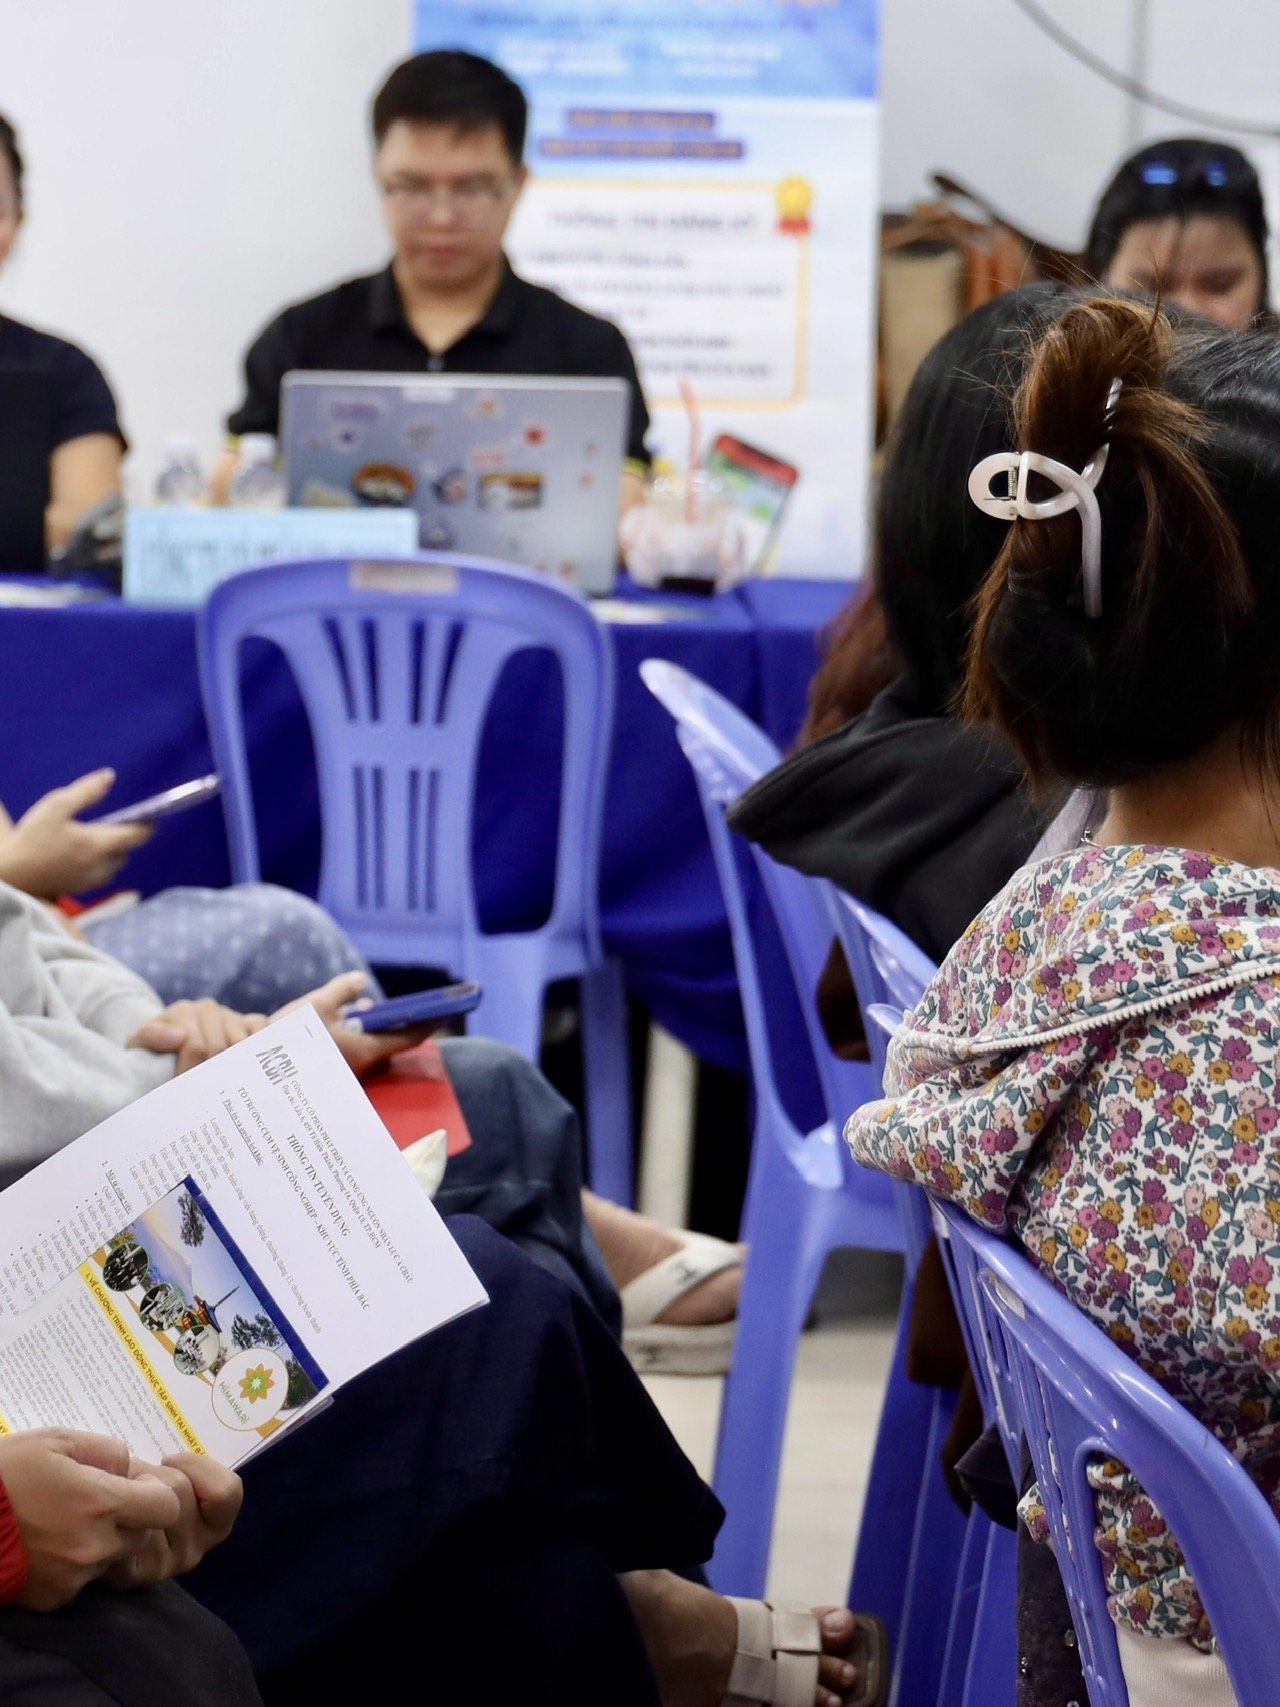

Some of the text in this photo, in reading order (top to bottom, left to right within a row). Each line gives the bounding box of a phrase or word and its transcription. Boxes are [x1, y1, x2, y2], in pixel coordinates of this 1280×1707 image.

[276, 1153, 290, 1171] SINH
[316, 1224, 330, 1240] KHU
[286, 1133, 311, 1165] THÔNG
[304, 1164, 318, 1181] TIN
[329, 1209, 351, 1237] DỤNG
[124, 1334, 136, 1350] LAO
[165, 1400, 179, 1418] SINH
